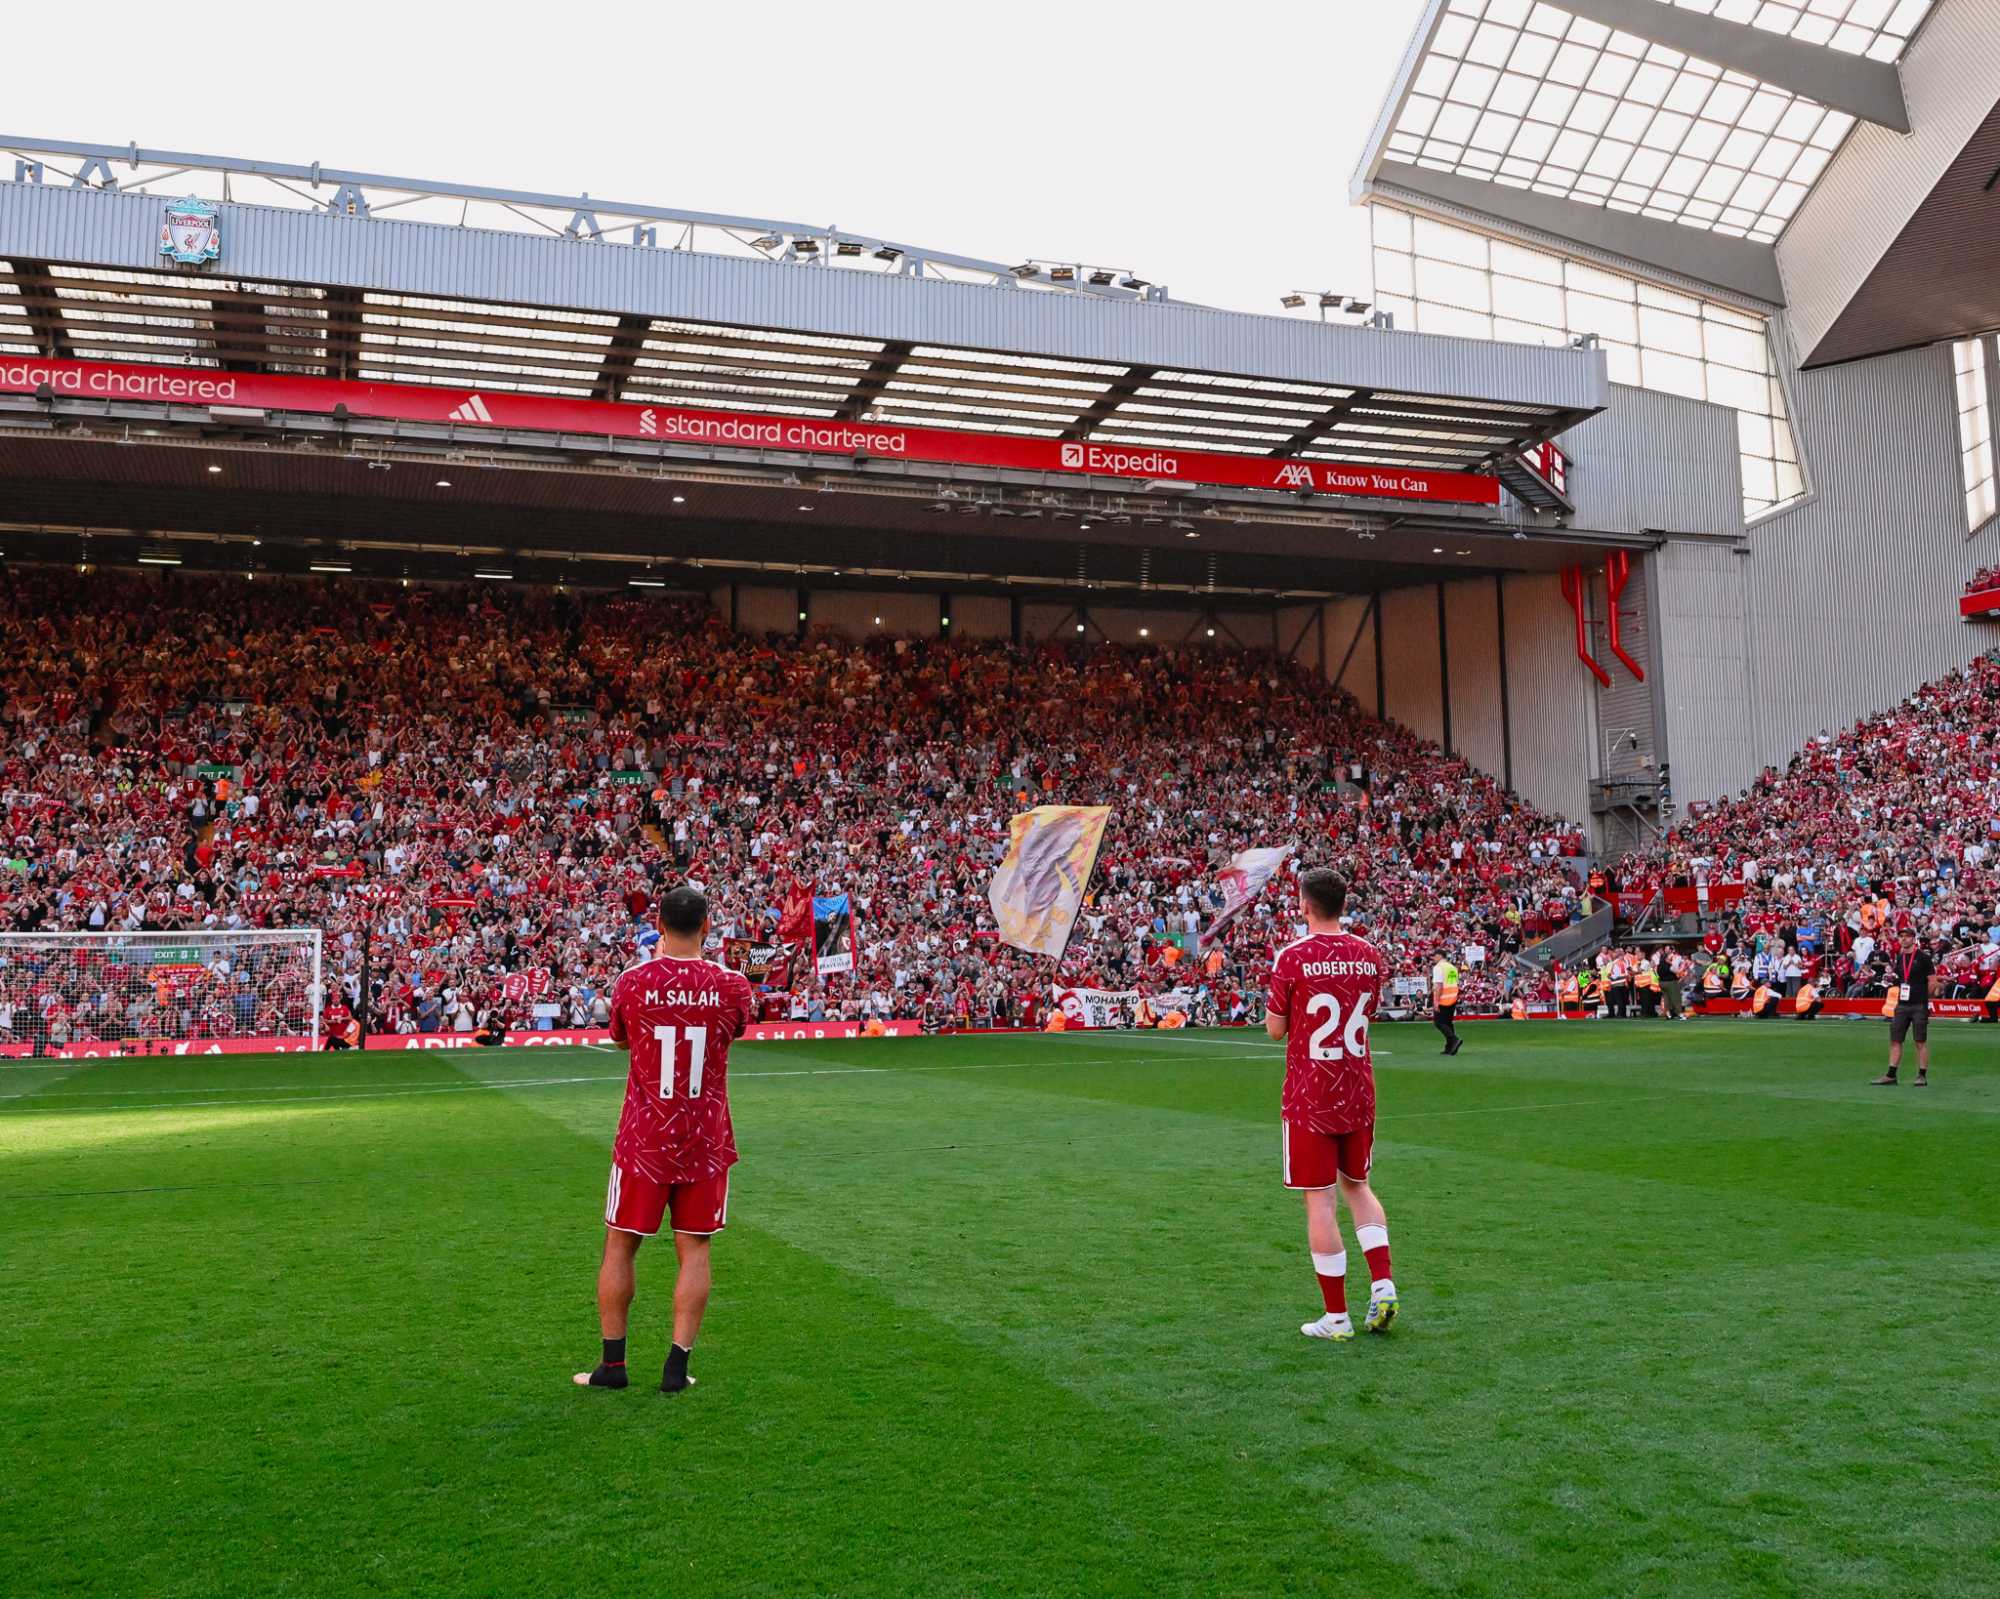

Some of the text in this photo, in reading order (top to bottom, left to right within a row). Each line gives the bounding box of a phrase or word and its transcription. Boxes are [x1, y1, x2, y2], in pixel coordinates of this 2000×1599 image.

[90, 369, 236, 400] chartered
[665, 415, 905, 452] standard chartered
[1088, 447, 1178, 474] Expedia
[1273, 464, 1315, 487] AXA
[1326, 471, 1429, 492] Know You Can
[154, 951, 176, 959] EXIT
[1302, 961, 1378, 977] ROBERTSON
[1085, 995, 1139, 1005] MOHAMED
[756, 1027, 898, 1040] SHOP NW
[1306, 992, 1372, 1060] 26
[654, 1025, 707, 1099] 11
